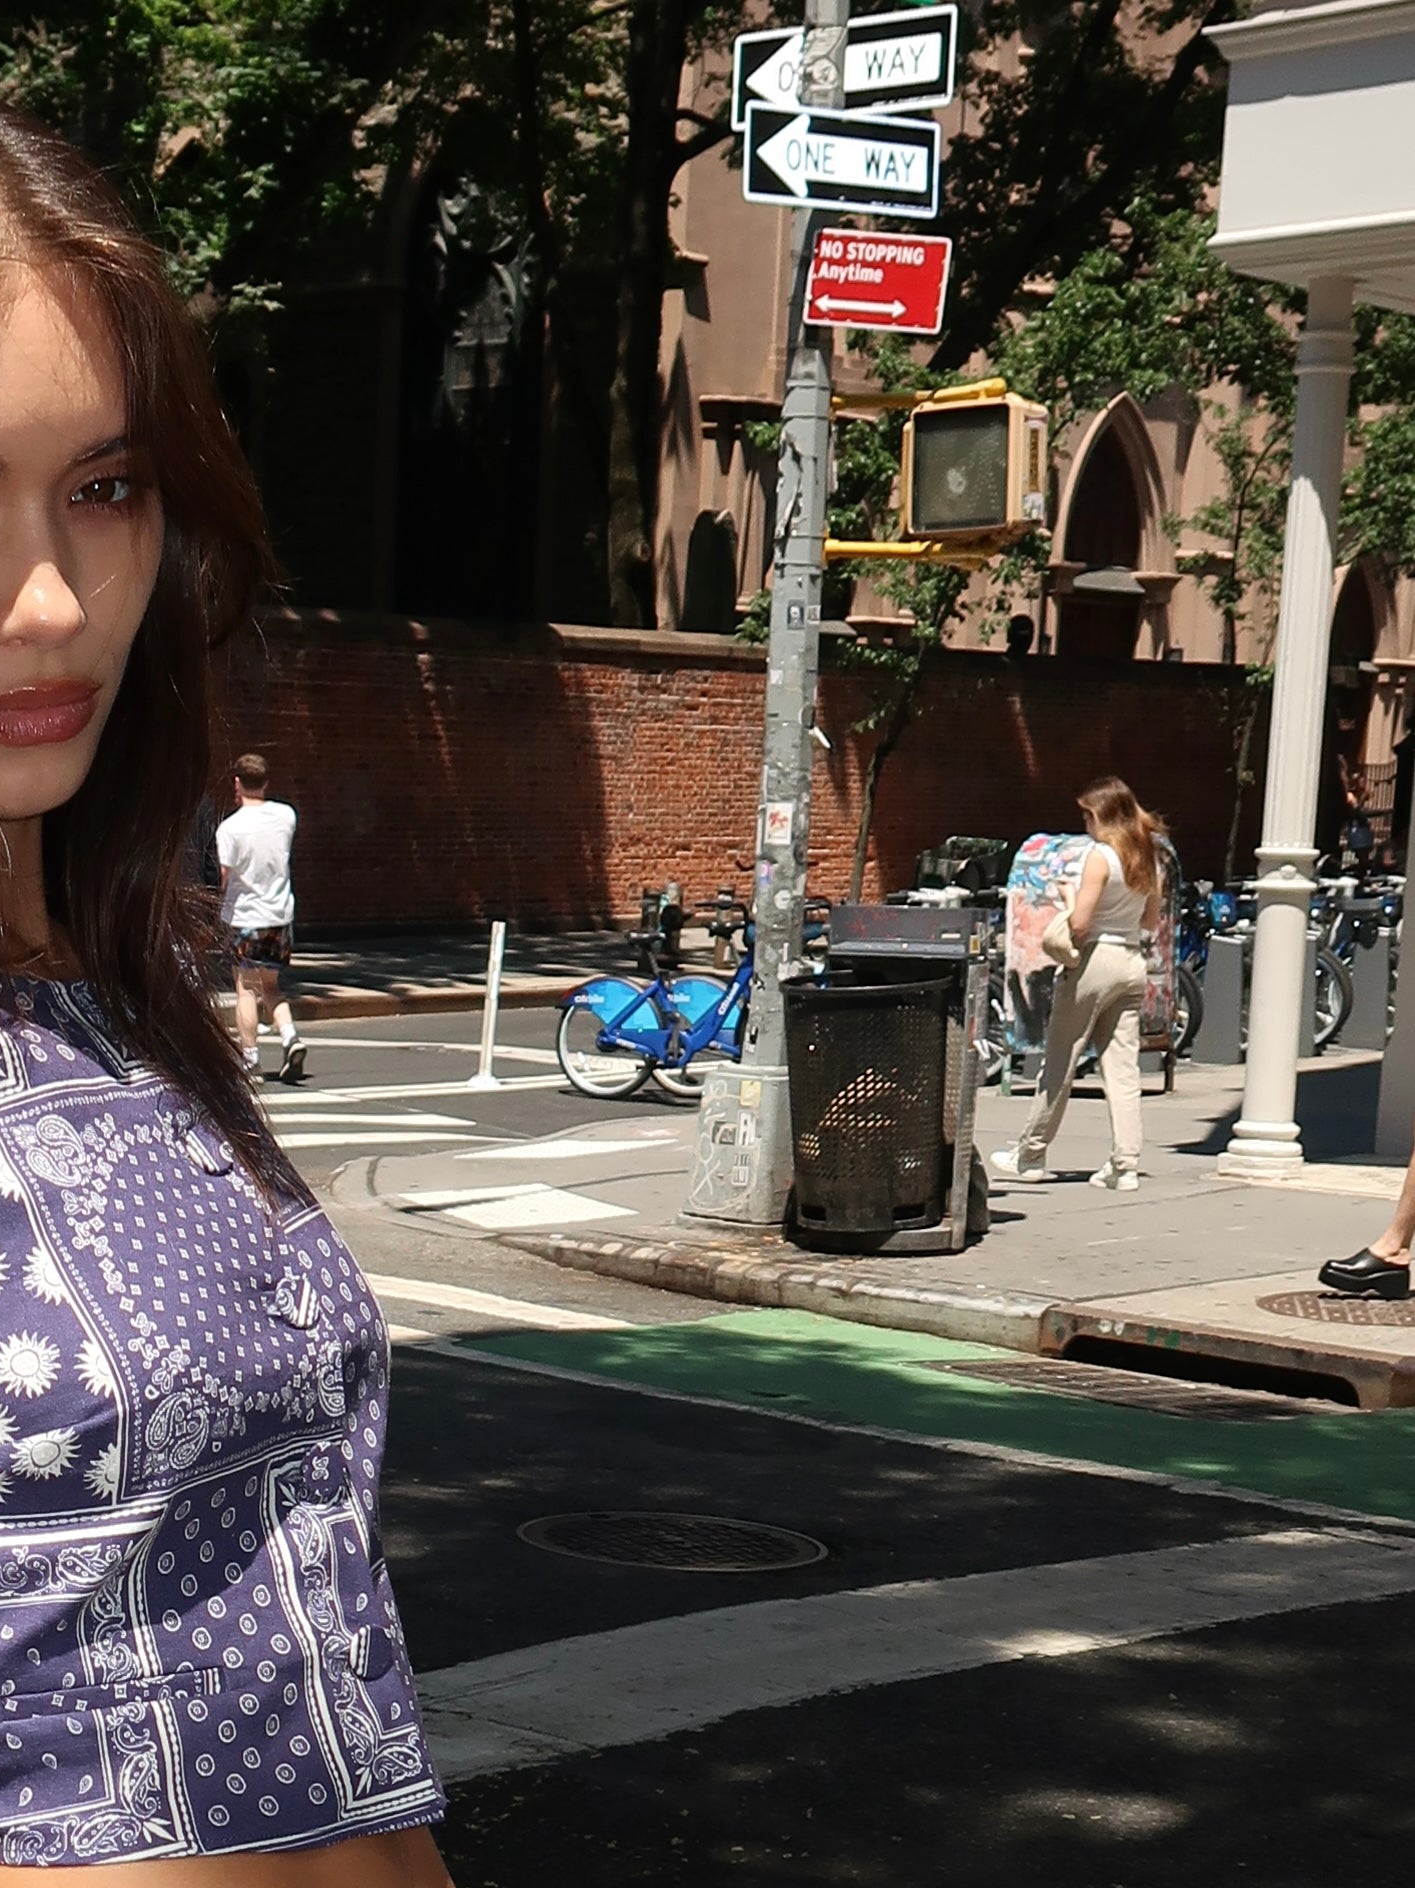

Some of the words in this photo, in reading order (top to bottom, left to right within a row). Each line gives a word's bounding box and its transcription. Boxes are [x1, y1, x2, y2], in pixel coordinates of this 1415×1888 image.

[865, 43, 926, 80] WAY
[786, 139, 835, 174] ONE
[864, 147, 916, 182] WAY
[819, 240, 843, 259] NO
[846, 242, 924, 266] STOPPING
[817, 261, 883, 284] Anytime
